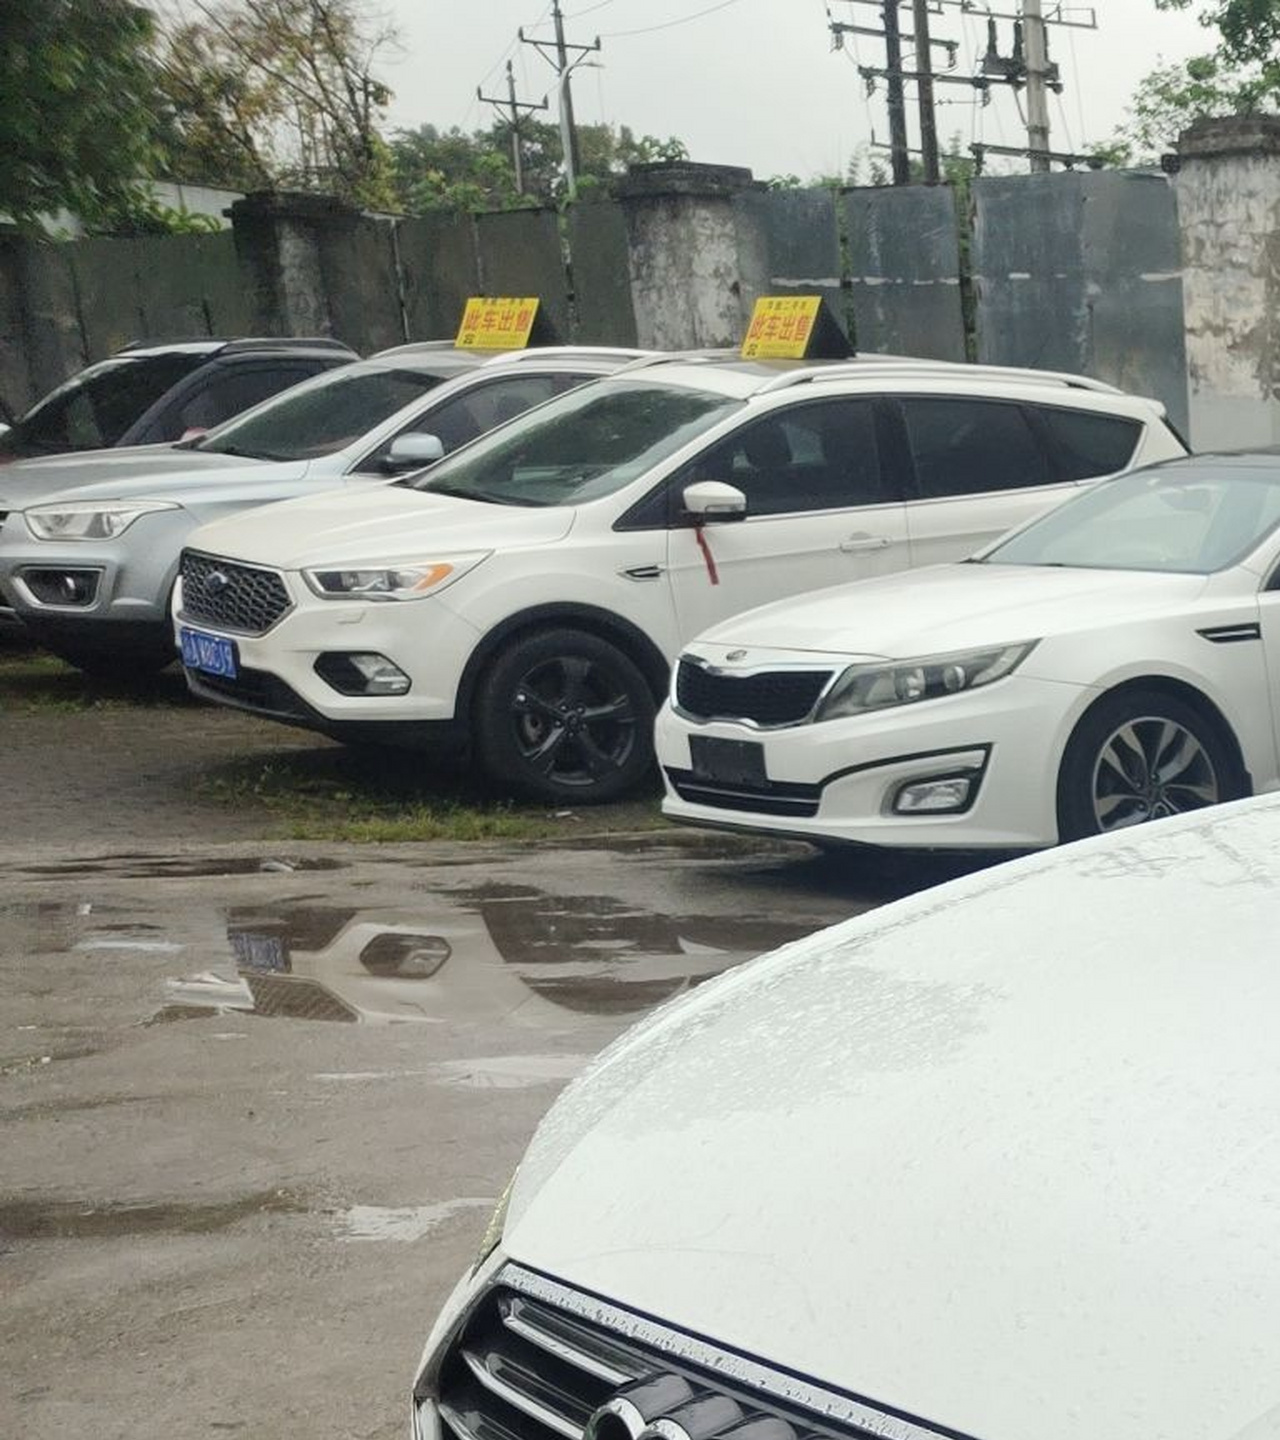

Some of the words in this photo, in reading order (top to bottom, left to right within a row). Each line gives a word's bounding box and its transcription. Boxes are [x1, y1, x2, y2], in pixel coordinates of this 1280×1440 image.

[464, 309, 530, 331] 此车出售
[749, 313, 809, 341] 此车出售
